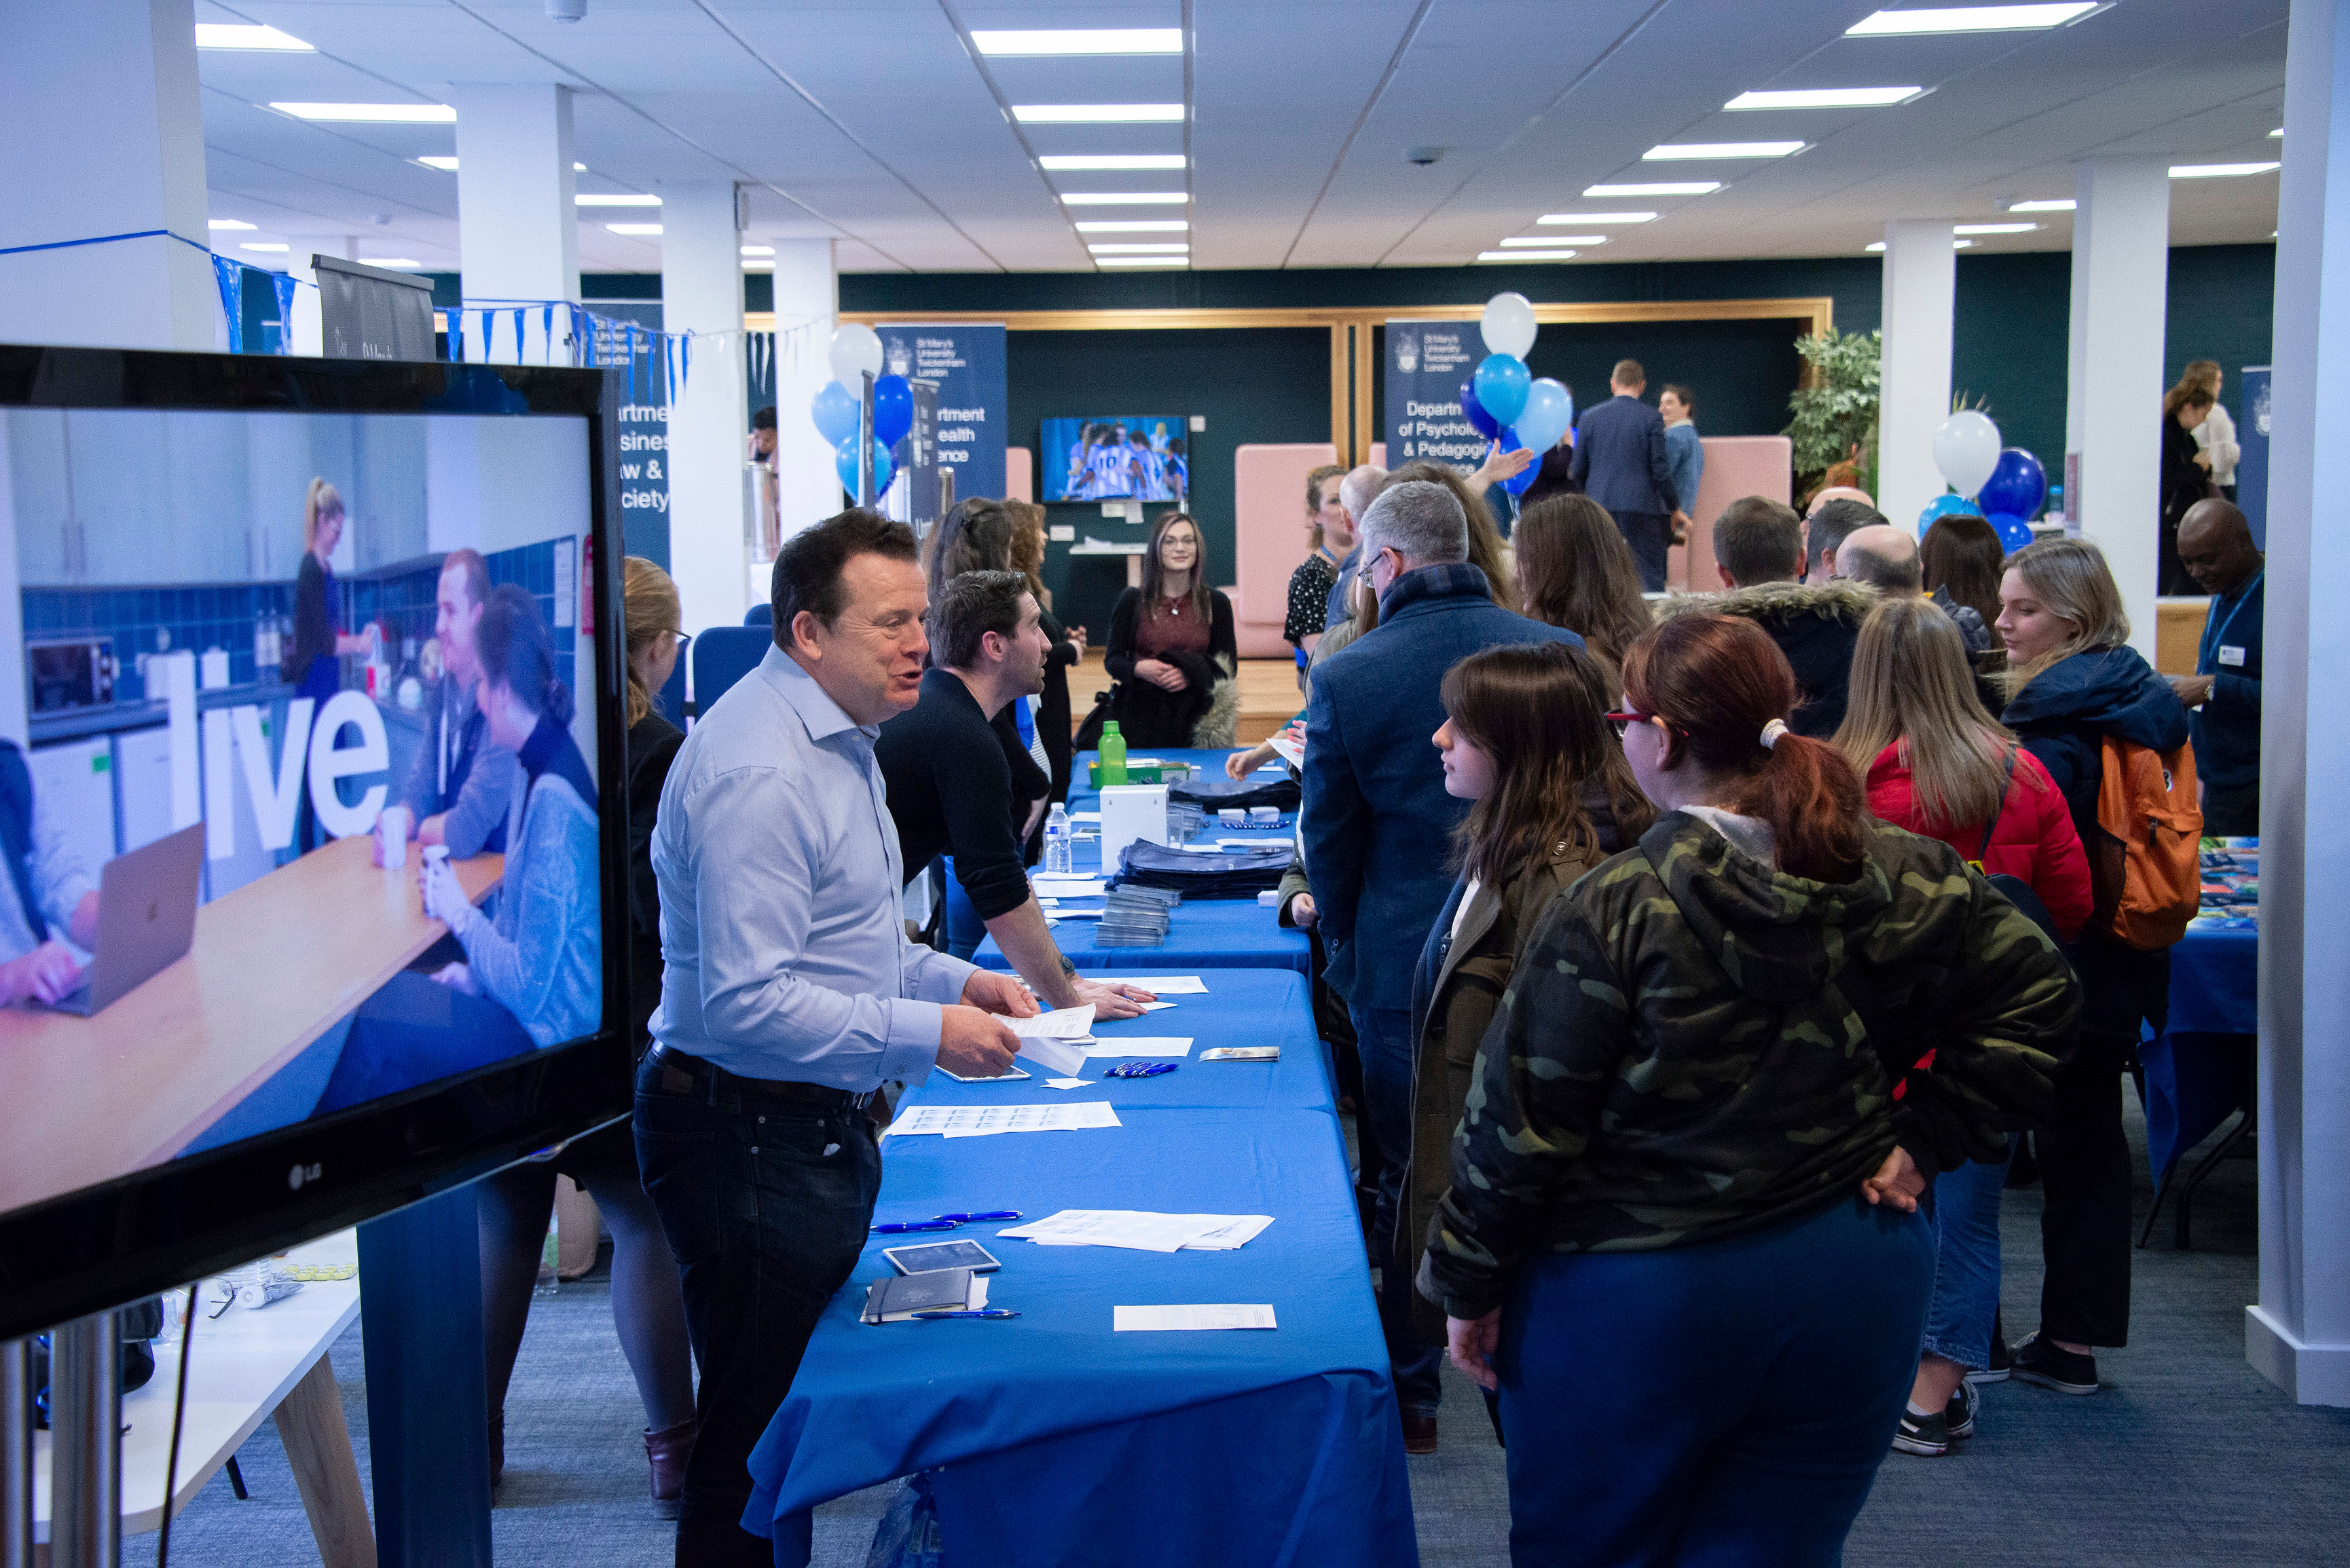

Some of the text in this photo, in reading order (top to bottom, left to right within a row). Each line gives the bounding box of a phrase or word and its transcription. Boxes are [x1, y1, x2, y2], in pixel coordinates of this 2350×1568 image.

[619, 404, 669, 422] rtme
[938, 427, 976, 442] ealth
[1399, 421, 1414, 436] of
[1403, 441, 1414, 457] &
[646, 459, 663, 480] &
[1100, 455, 1117, 469] 10
[167, 648, 390, 861] live
[305, 1161, 322, 1182] LG
